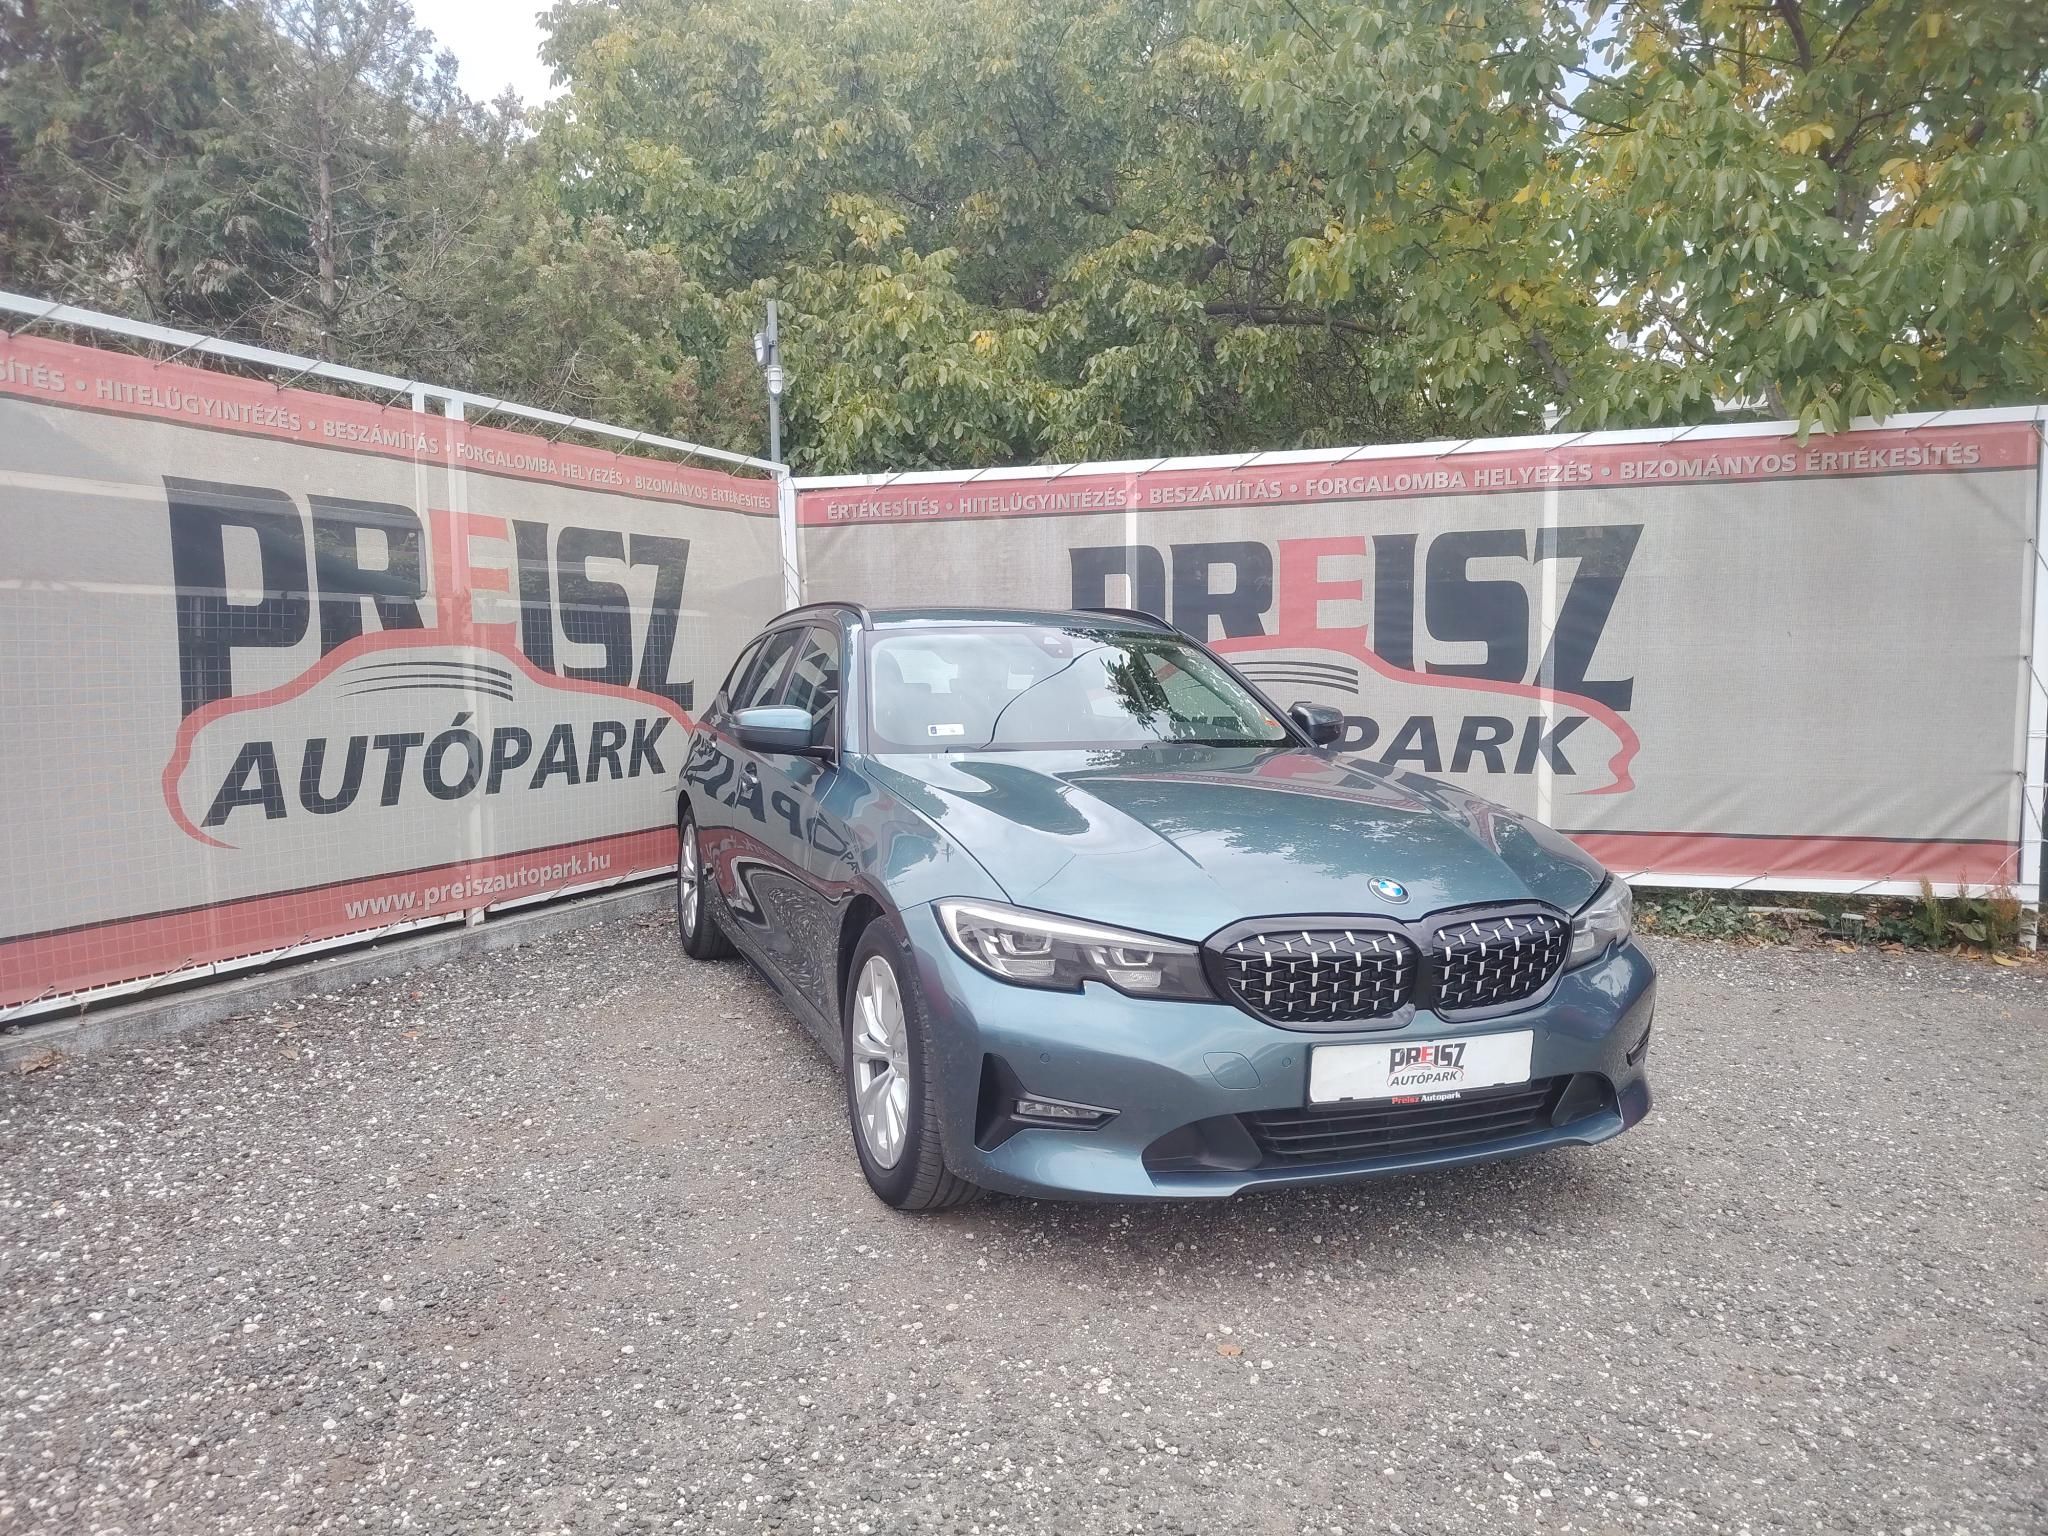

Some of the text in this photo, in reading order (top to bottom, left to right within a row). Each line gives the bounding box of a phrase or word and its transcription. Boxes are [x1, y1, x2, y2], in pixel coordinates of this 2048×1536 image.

[96, 378, 301, 431] HITELÜGYINTÉZÉS
[323, 417, 439, 455] BESZÁMÍTÁS
[456, 442, 558, 476] FORGALOMBA
[561, 462, 623, 486] HELYEZÉS
[635, 475, 708, 500] BIZOMÁNYOS
[827, 442, 1981, 520] ÉRTÉKESÍTÉS HITELÜGYINTÉZÉS BESZÁMÍTÁS FORGALOMBA HELYEZÉS BIZOMÁNYOS ÉRTÉKESÍTÉS
[161, 474, 695, 722] PREISZ
[199, 711, 672, 828] AUTÓPARK
[344, 852, 612, 921] www.preiszautopark.hu
[1389, 1042, 1467, 1074] PREISZ
[1390, 1070, 1459, 1087] AUTÓPARK
[1420, 1091, 1462, 1103] Autopark
